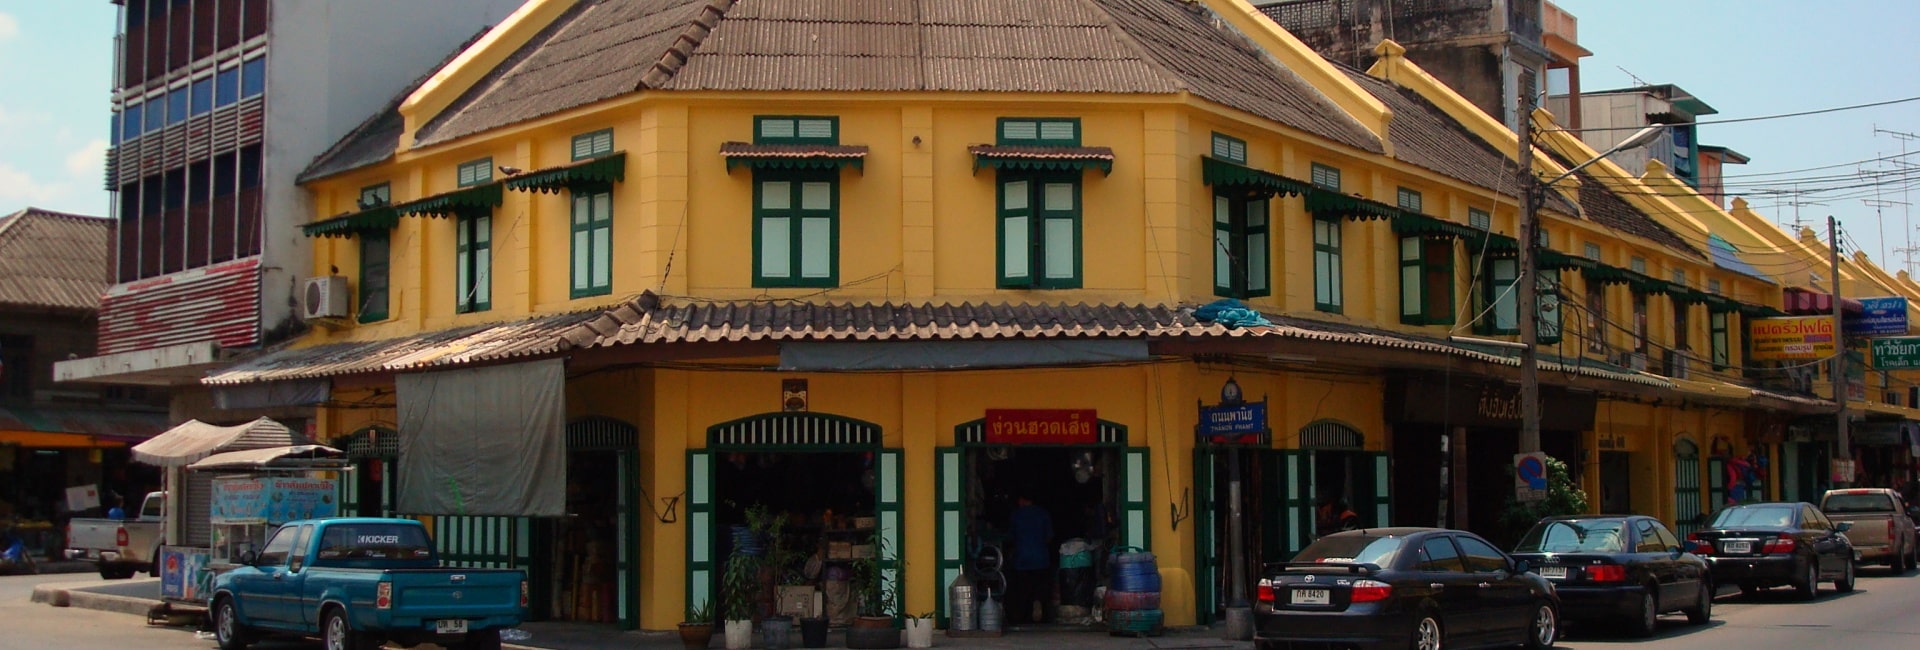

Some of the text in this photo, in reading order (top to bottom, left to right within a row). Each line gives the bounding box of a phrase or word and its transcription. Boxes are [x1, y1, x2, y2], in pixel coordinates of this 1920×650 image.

[1211, 406, 1253, 423] ถนนพานิช
[992, 412, 1091, 436] ง่วนฮวดเส็ง
[365, 535, 398, 544] KICKER
[1307, 590, 1324, 598] 8420
